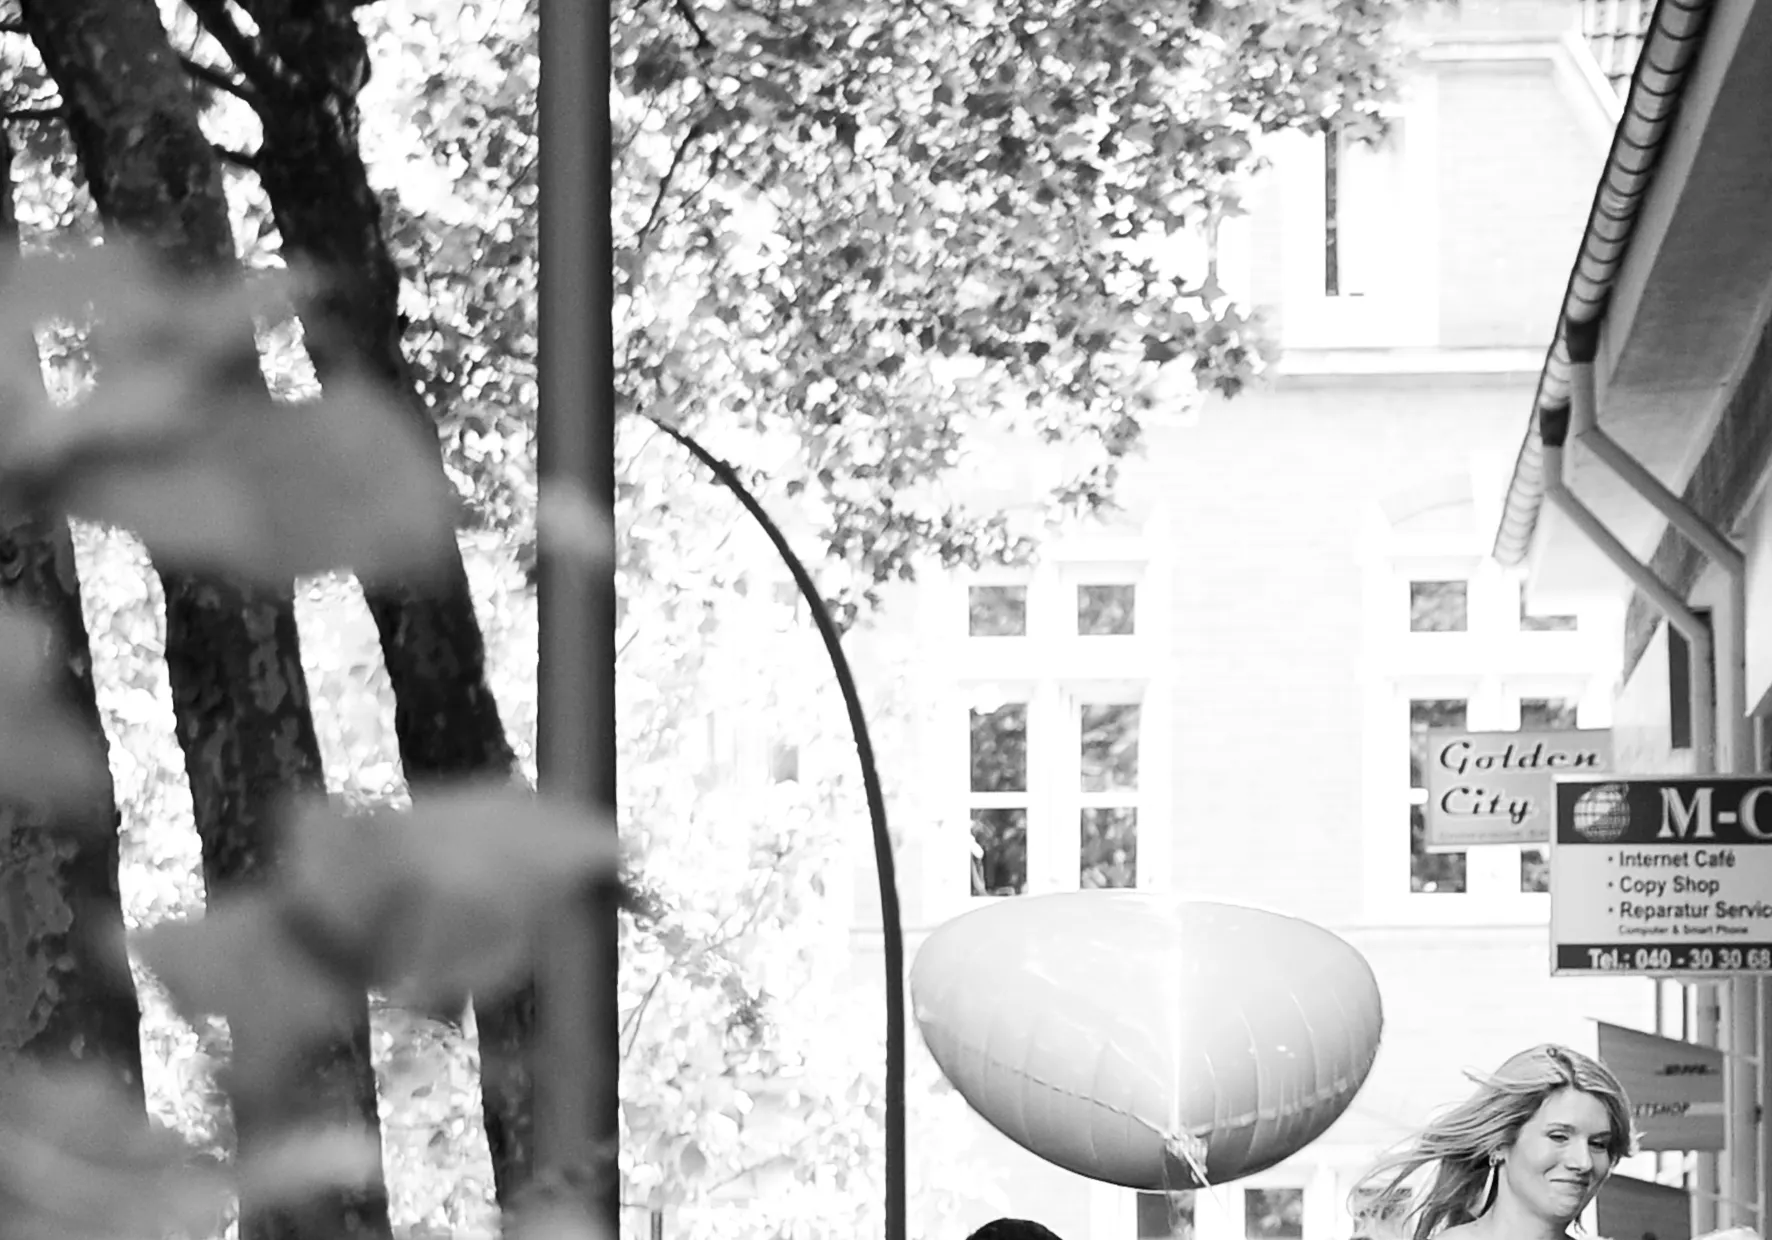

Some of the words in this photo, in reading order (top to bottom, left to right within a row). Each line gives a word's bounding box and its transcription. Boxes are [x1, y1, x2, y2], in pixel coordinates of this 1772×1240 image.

[1440, 741, 1600, 774] Golden
[1440, 786, 1529, 824] City
[1619, 850, 1689, 868] Internet
[1695, 848, 1736, 868] Café
[1619, 876, 1667, 894] Copy
[1673, 875, 1720, 895] Shop
[1619, 901, 1709, 920] Reparatur
[1635, 948, 1672, 969] 040
[1689, 948, 1713, 969] 30
[1718, 948, 1742, 969] 30
[1747, 948, 1771, 969] 68
